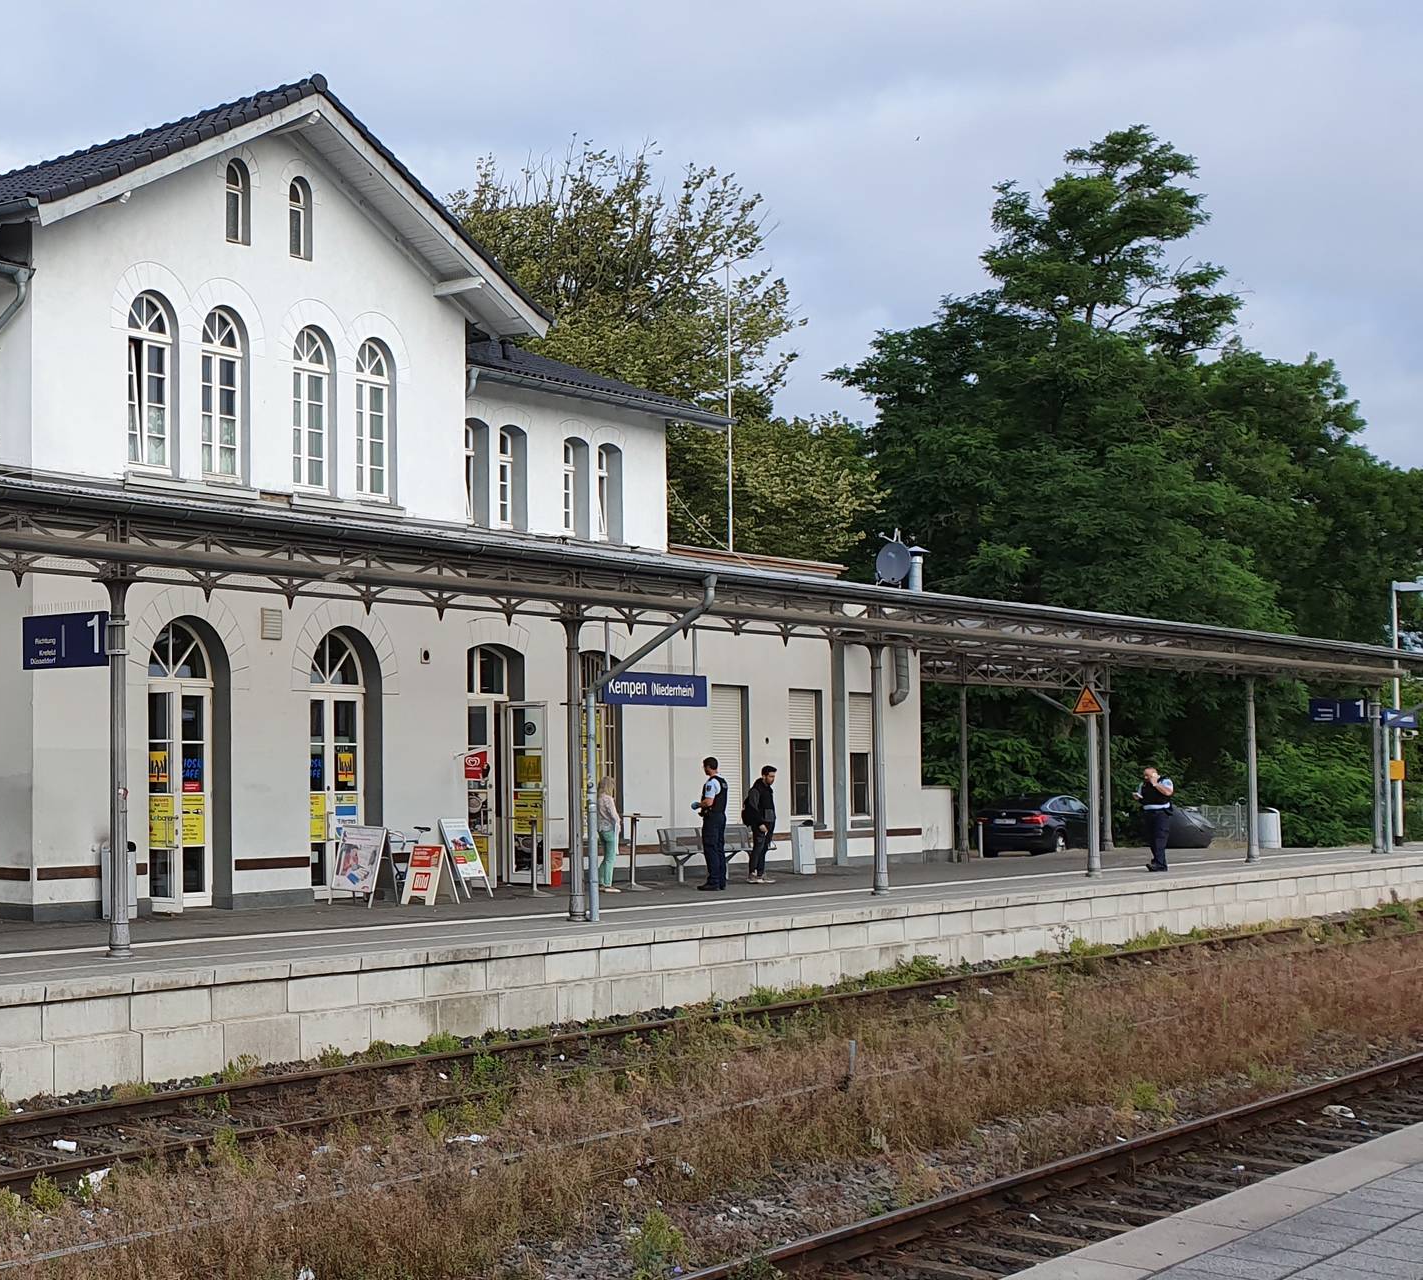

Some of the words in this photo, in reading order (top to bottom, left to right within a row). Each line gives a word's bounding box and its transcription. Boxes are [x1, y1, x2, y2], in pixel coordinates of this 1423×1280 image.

[86, 613, 100, 654] 1
[34, 638, 56, 646] Richtung
[38, 649, 57, 657] Krefeld
[30, 657, 57, 665] Düsseldorf
[608, 678, 648, 699] Kempen
[651, 681, 695, 699] (Niederrhein)
[1354, 699, 1366, 718] 1
